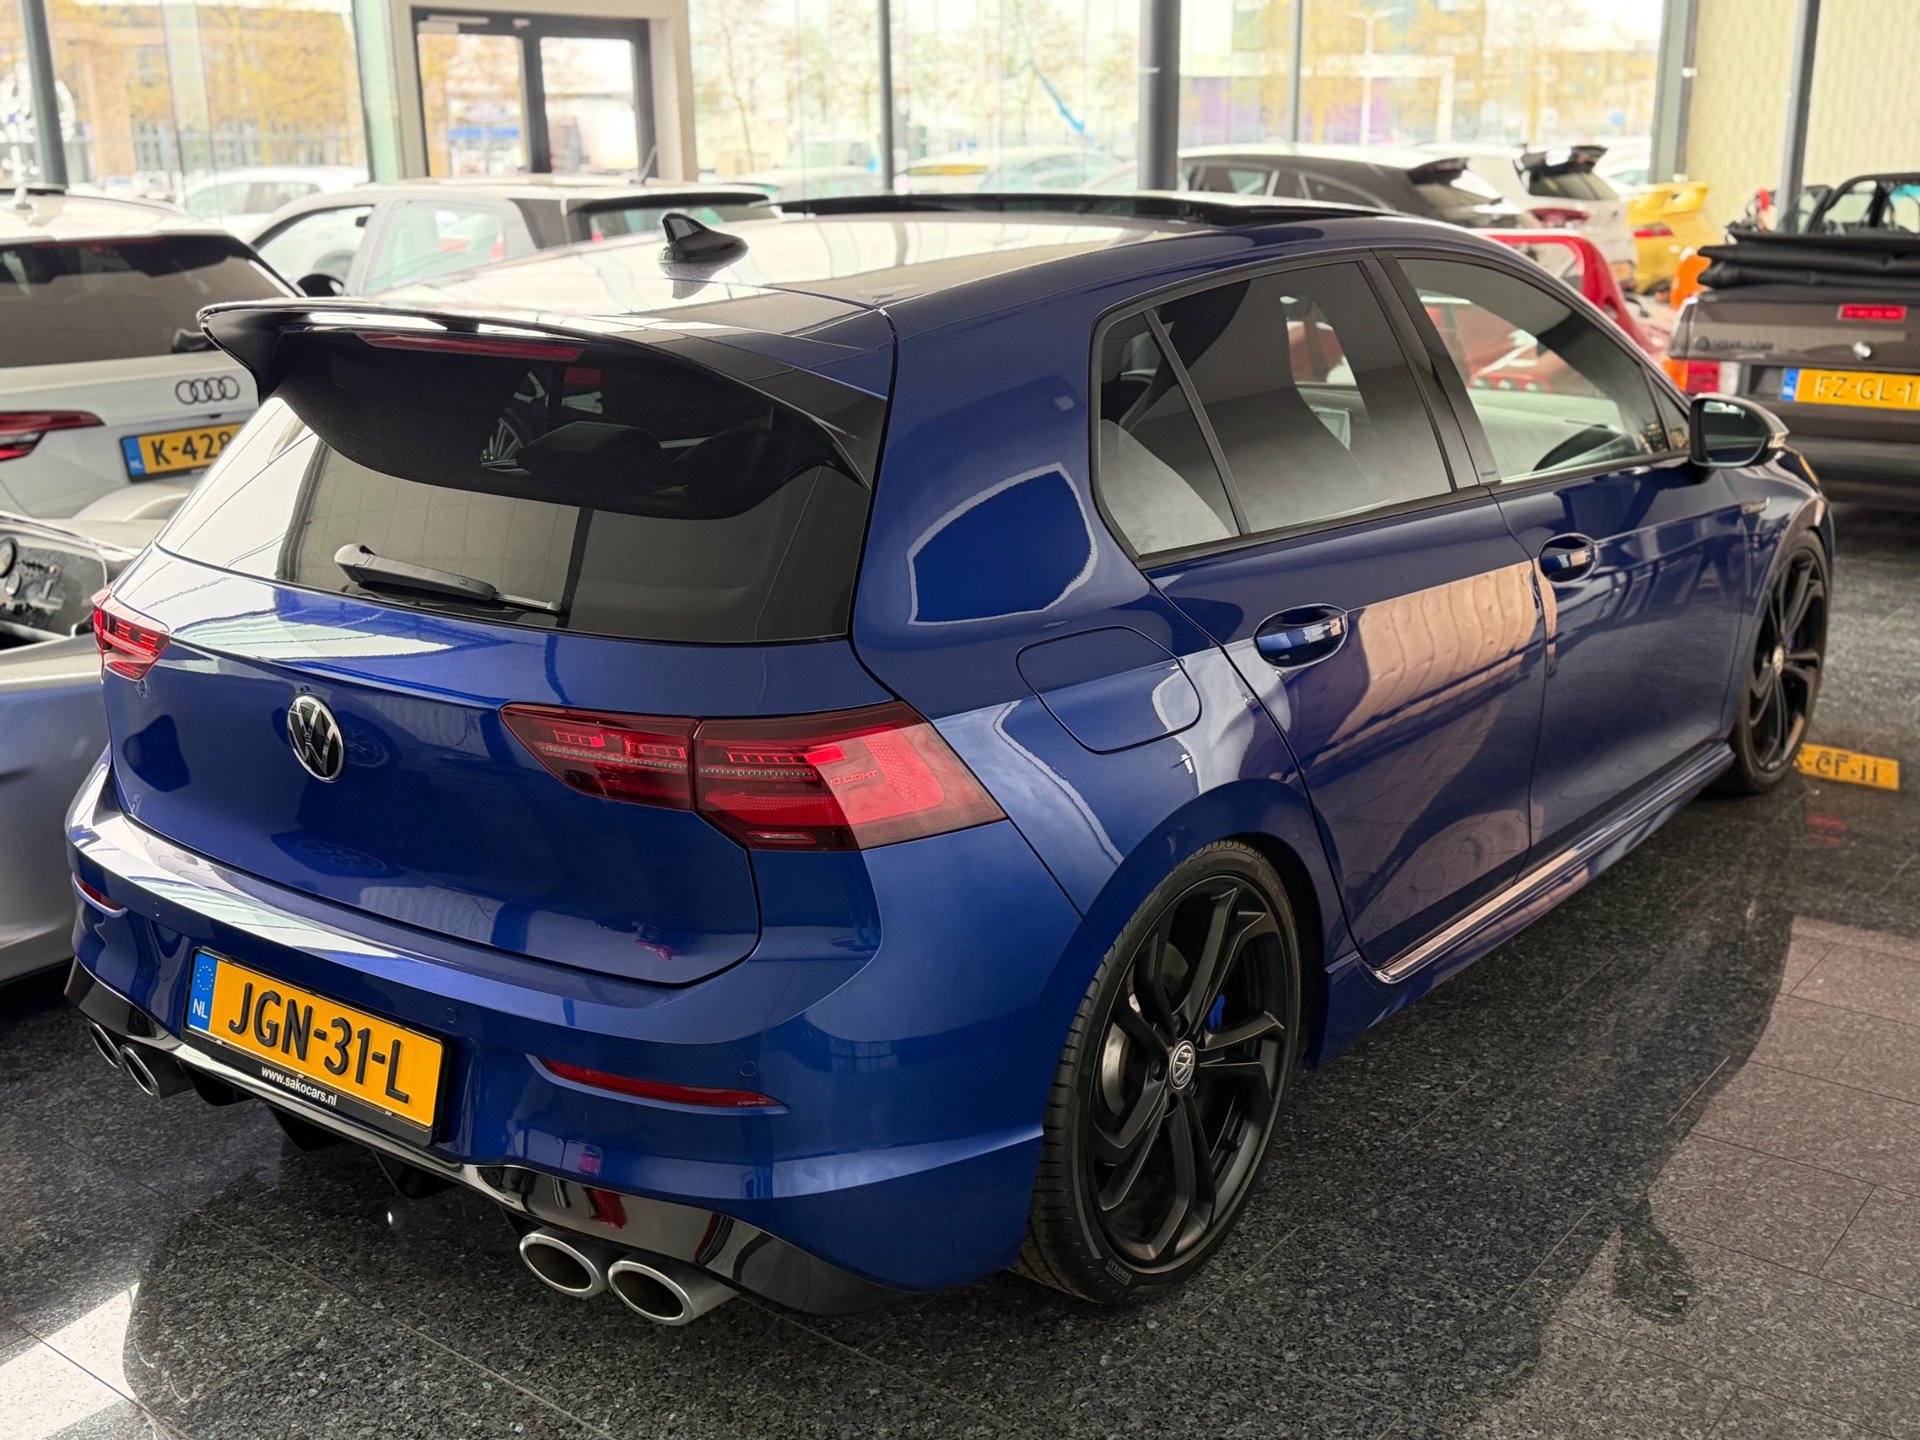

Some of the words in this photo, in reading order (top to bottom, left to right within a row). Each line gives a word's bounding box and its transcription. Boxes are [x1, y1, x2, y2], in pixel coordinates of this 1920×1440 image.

[192, 998, 209, 1019] NL
[228, 982, 410, 1104] JGN-31-L
[261, 1066, 338, 1107] www.sakocars.nl
